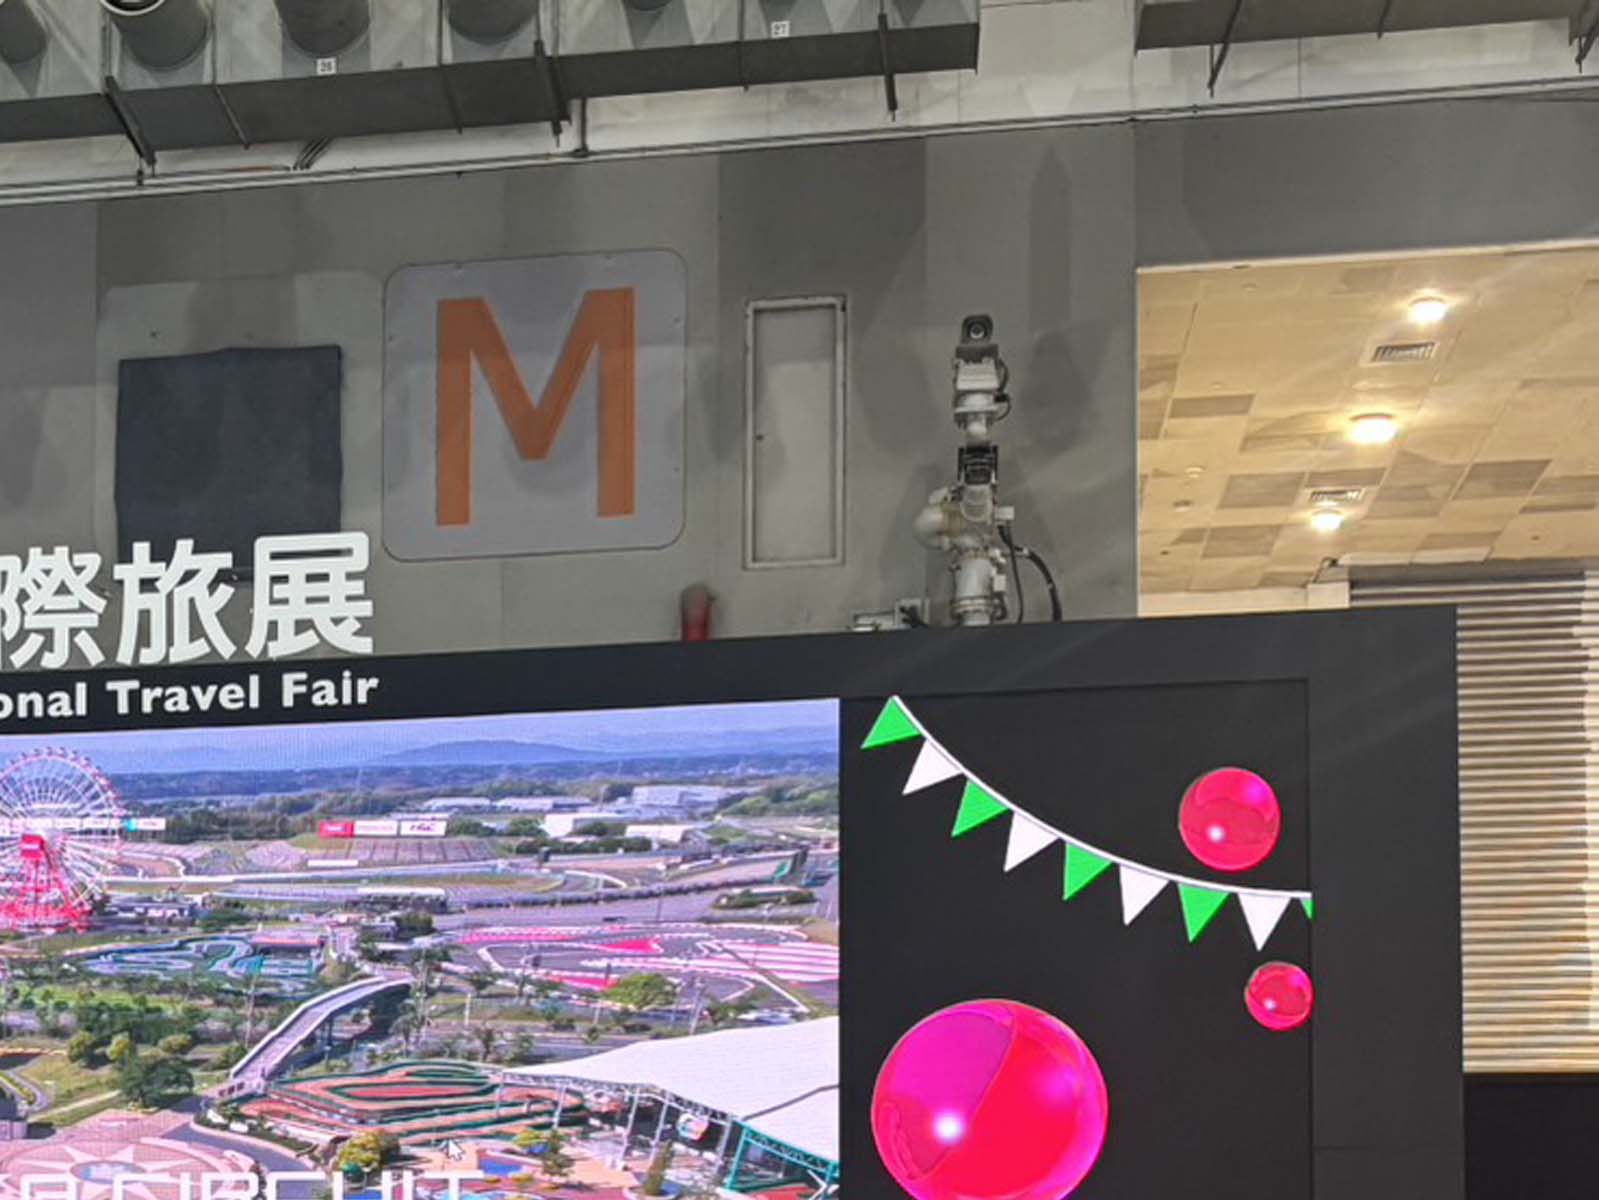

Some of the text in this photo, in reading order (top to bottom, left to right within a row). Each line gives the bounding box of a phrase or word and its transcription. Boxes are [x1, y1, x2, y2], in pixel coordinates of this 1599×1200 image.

[436, 286, 635, 526] M
[106, 673, 260, 714] Travel
[282, 670, 380, 708] Fair
